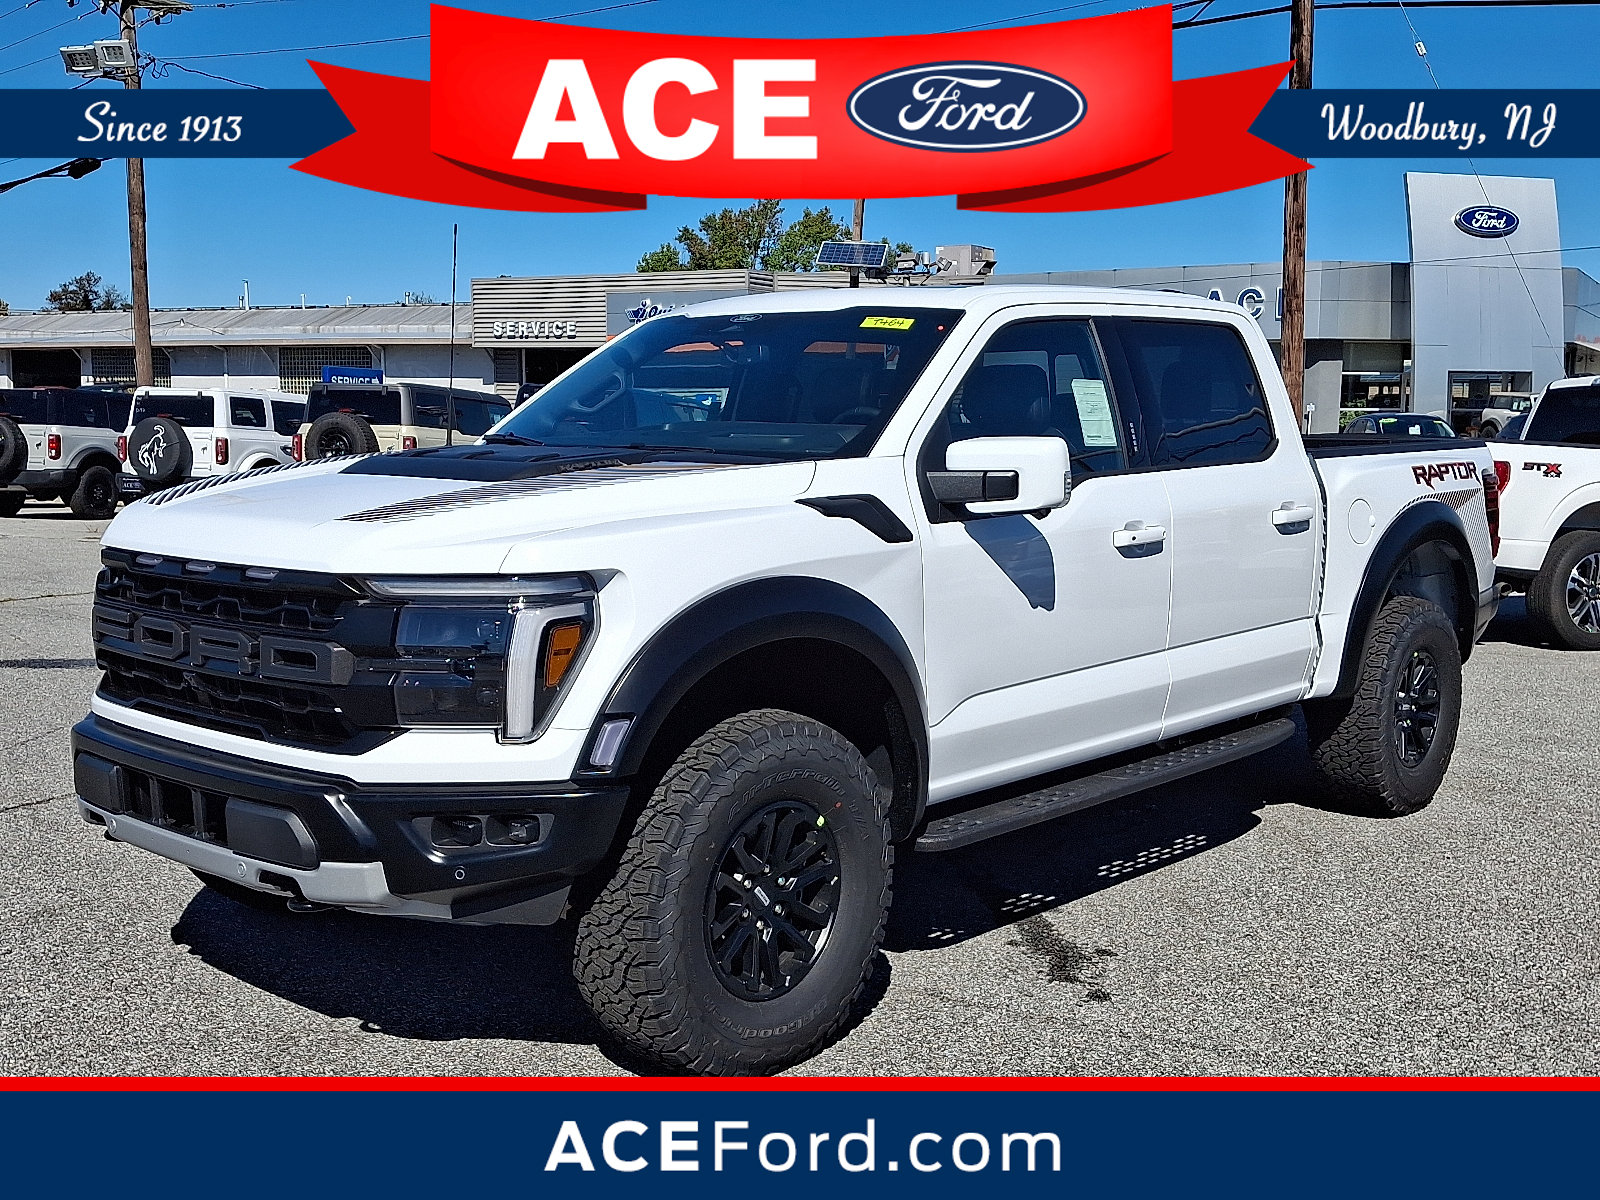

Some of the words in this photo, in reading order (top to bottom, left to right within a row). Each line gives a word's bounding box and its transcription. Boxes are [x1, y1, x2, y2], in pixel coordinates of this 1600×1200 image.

[493, 320, 578, 337] SERVICE
[1411, 461, 1483, 491] RAPTOR
[1522, 462, 1562, 475] STX
[92, 604, 354, 686] FORD
